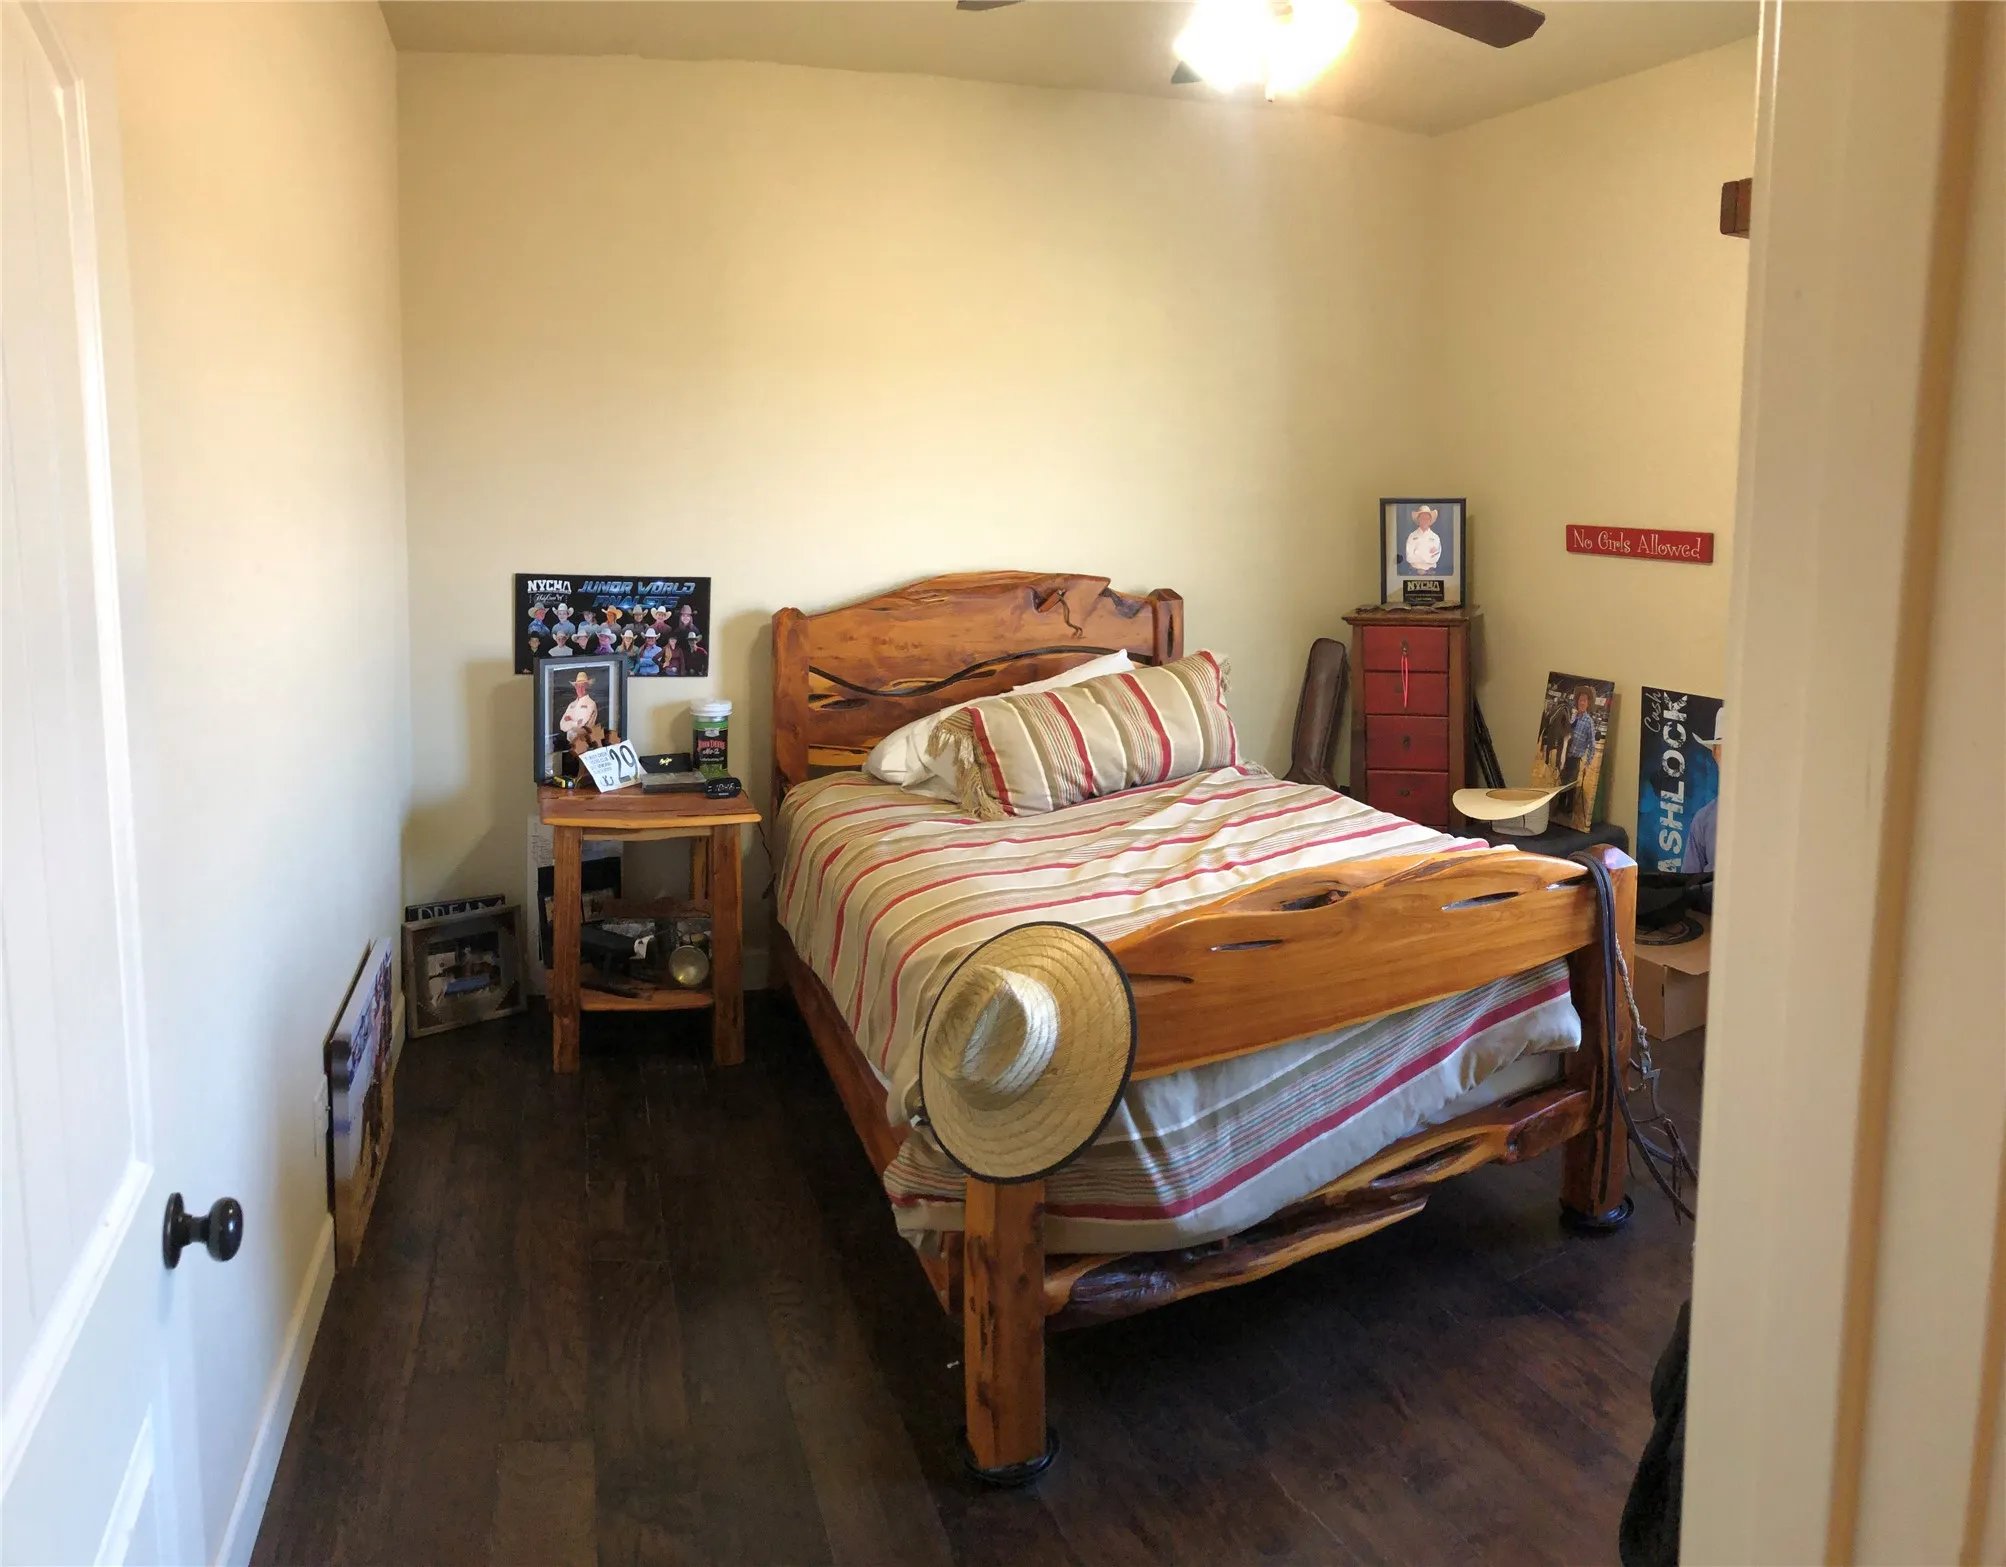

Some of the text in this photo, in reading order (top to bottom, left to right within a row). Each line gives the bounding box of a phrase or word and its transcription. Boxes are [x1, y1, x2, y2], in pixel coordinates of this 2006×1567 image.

[1573, 528, 1701, 559] No Girls Allowed
[527, 579, 572, 594] NYCHA
[577, 580, 696, 595] JUNIOR WORLD
[1644, 691, 1662, 733] Cash
[609, 745, 639, 784] 29
